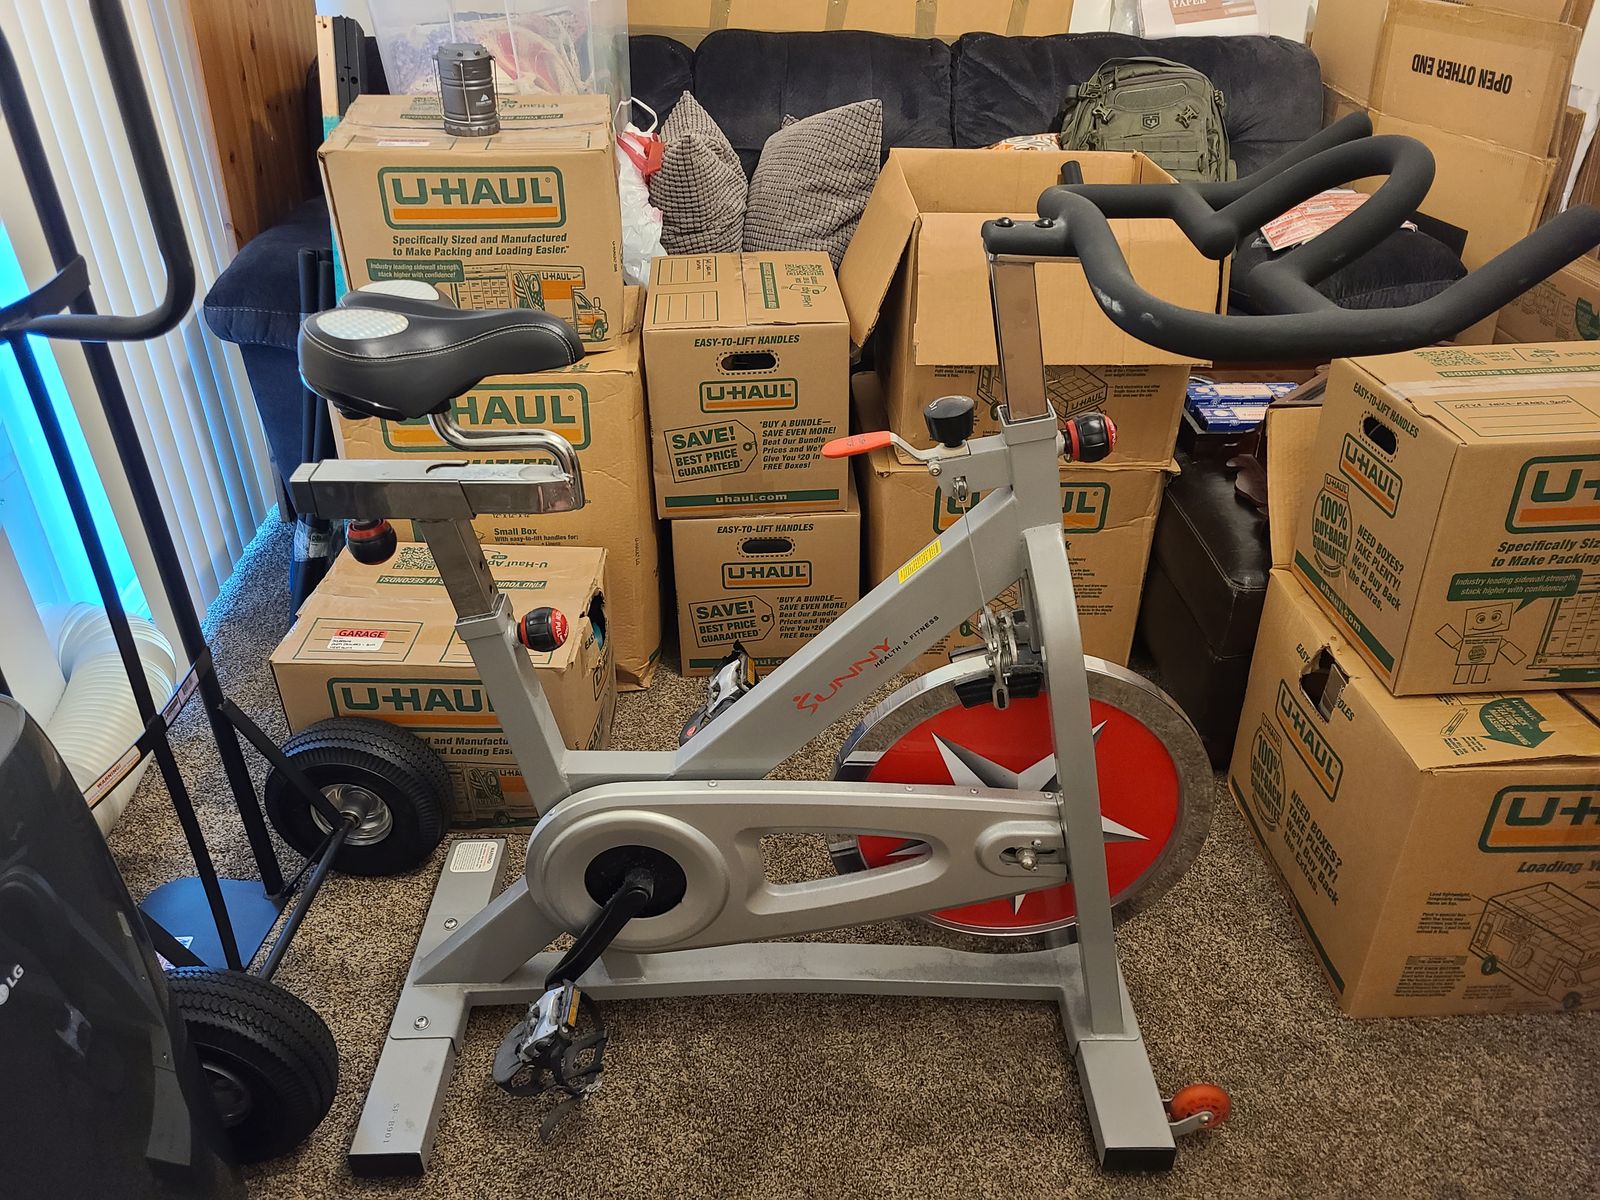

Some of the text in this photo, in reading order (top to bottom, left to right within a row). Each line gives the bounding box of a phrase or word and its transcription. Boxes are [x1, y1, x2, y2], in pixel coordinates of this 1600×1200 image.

[1411, 53, 1513, 95] OPEN OTHER END
[391, 177, 553, 205] U-HAUL
[392, 233, 567, 246] Specifically Sized and Manufactured
[393, 247, 403, 257] to
[405, 246, 431, 257] Make
[434, 246, 472, 257] Packing
[475, 247, 492, 256] and
[496, 246, 533, 257] Loading
[694, 334, 800, 347] EASY-TO-LIFT HANDLES
[706, 384, 792, 400] U-HAUL
[1353, 382, 1420, 438] EASY-TO-LIFT HANDLES
[671, 426, 736, 449] SAVE!
[762, 427, 836, 437] SAVE EVEN MORE!
[762, 438, 780, 446] Beat
[799, 436, 826, 444] Bundle
[675, 448, 738, 467] BEST PRICE
[762, 446, 787, 454] Prices
[1345, 441, 1397, 500] U-HAUL
[716, 493, 788, 503] uhaul.com
[1320, 494, 1348, 531] 100%
[494, 527, 537, 536] Small Box
[717, 523, 814, 534] EASY-TO-LIFT HANDLES
[1314, 517, 1348, 551] BUY-BACK
[510, 535, 543, 543] easy-to-lift
[1497, 538, 1578, 554] Specifically
[1357, 524, 1404, 574] NEED BOXES?
[485, 559, 548, 568] U-Haul Ap
[1355, 538, 1402, 591] TAKE PLENTY!
[1491, 552, 1600, 567] to Make Packing
[727, 566, 806, 579] U-HAUL
[1455, 573, 1577, 586] Industry leading sidewall strength,
[1348, 569, 1383, 611] the Extras.
[1351, 553, 1402, 611] We'll Buy Back
[1461, 584, 1567, 595] stack higher with confidence!
[696, 600, 755, 620] SAVE!
[779, 603, 799, 611] SAVE
[1320, 581, 1361, 632] uhaul.com
[338, 629, 385, 638] GARAGE
[699, 620, 757, 634] BEST PRICE
[874, 645, 902, 669] HEALTH
[909, 615, 940, 641] FITNESS
[792, 637, 891, 716] SUNNY
[434, 737, 509, 745] and Manufactu
[1281, 690, 1335, 782] U-HAUL
[450, 747, 489, 756] Loading
[1291, 790, 1343, 869] NEED BOXES?
[1289, 803, 1338, 884] TAKE PLENTY!
[1286, 817, 1339, 906] We'll Buy Back
[1517, 861, 1584, 875] Loading
[1295, 852, 1318, 895] Extras.
[6, 964, 24, 988] LG
